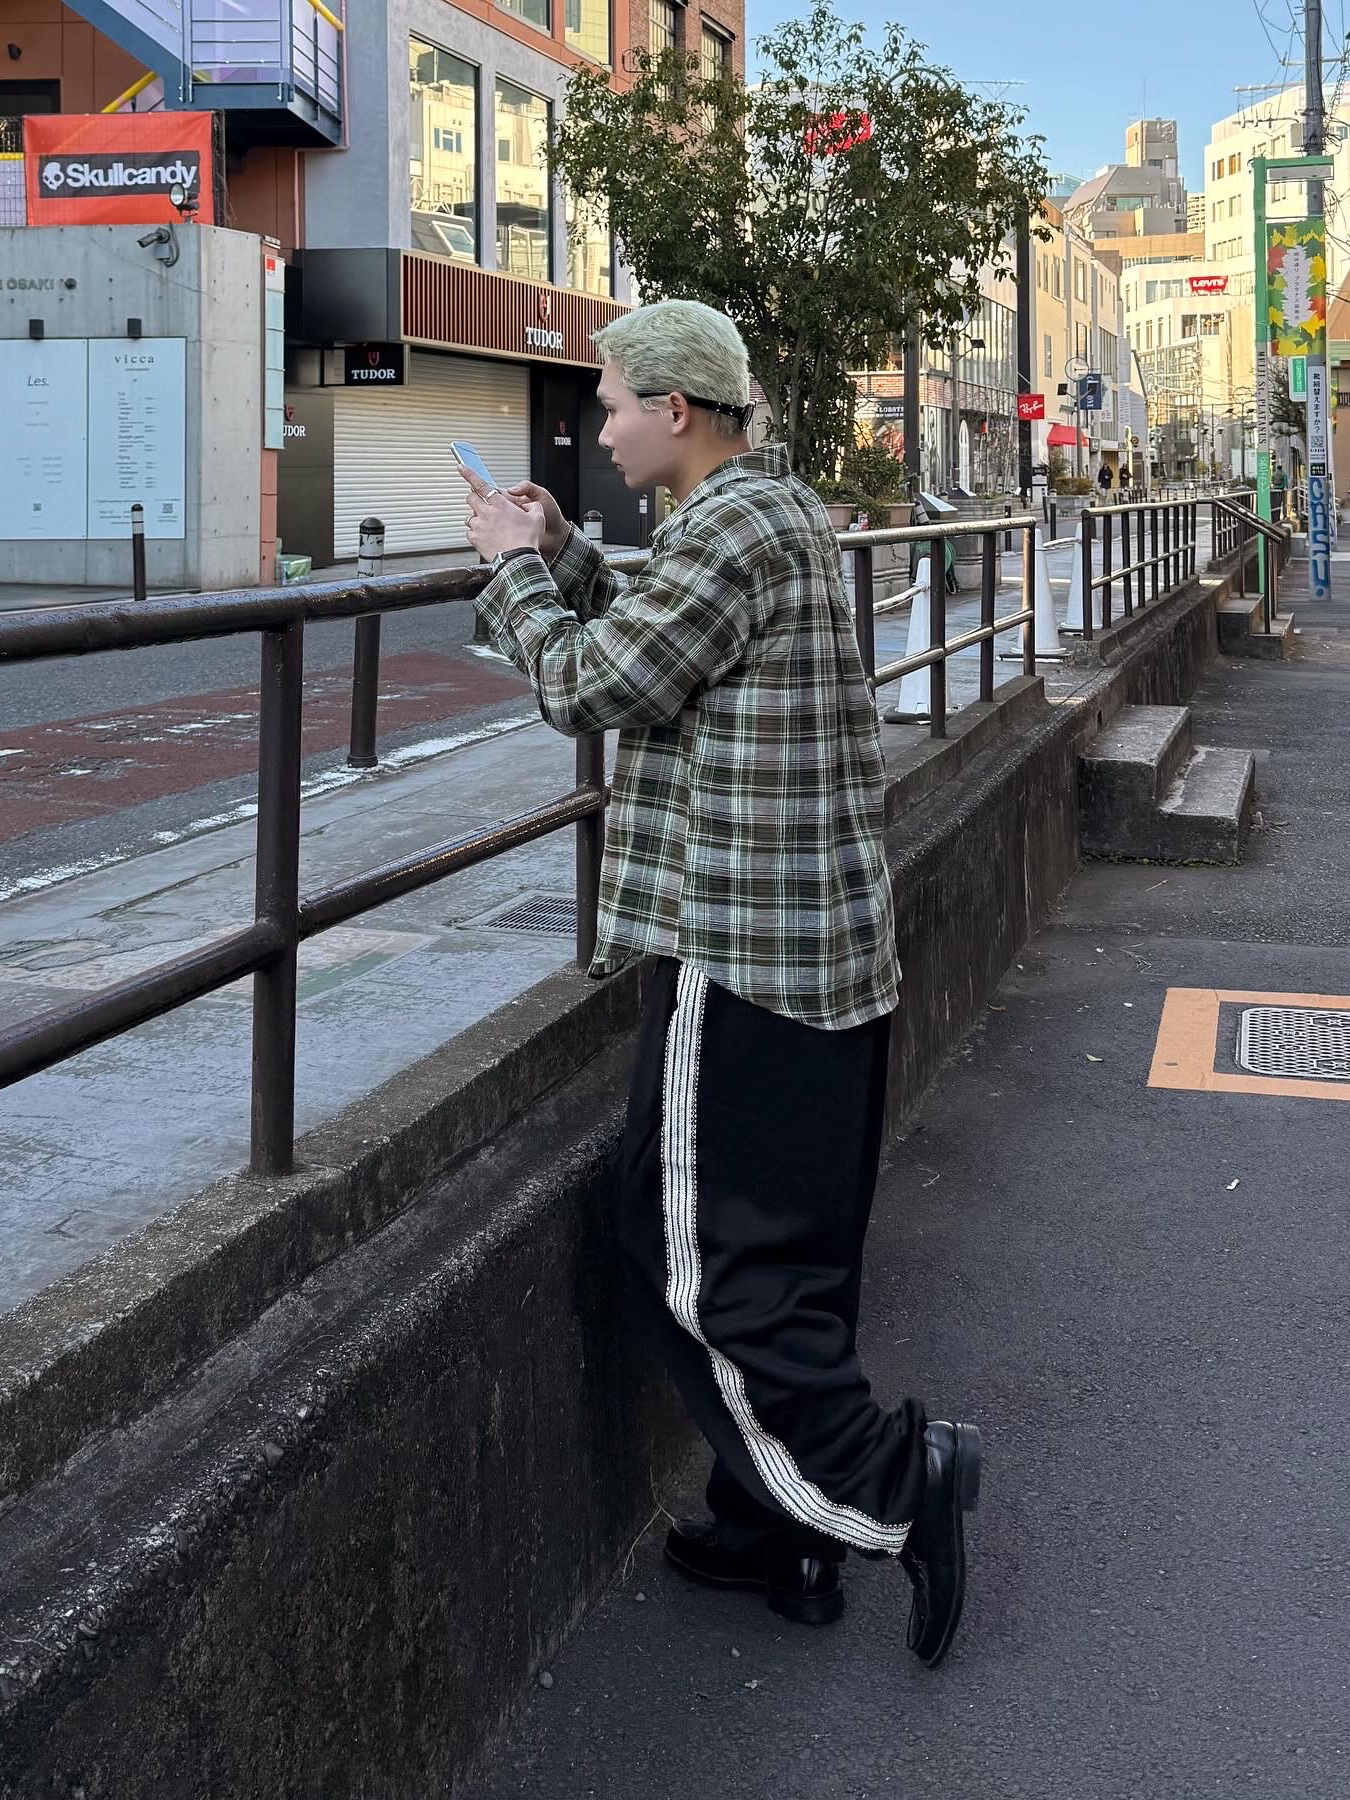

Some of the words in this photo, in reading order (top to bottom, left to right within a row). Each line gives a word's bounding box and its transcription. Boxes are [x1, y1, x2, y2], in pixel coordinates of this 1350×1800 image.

[525, 326, 563, 349] TUDOR
[351, 369, 395, 379] TUDOR
[283, 425, 306, 436] UDOR
[554, 436, 571, 445] TUDOR
